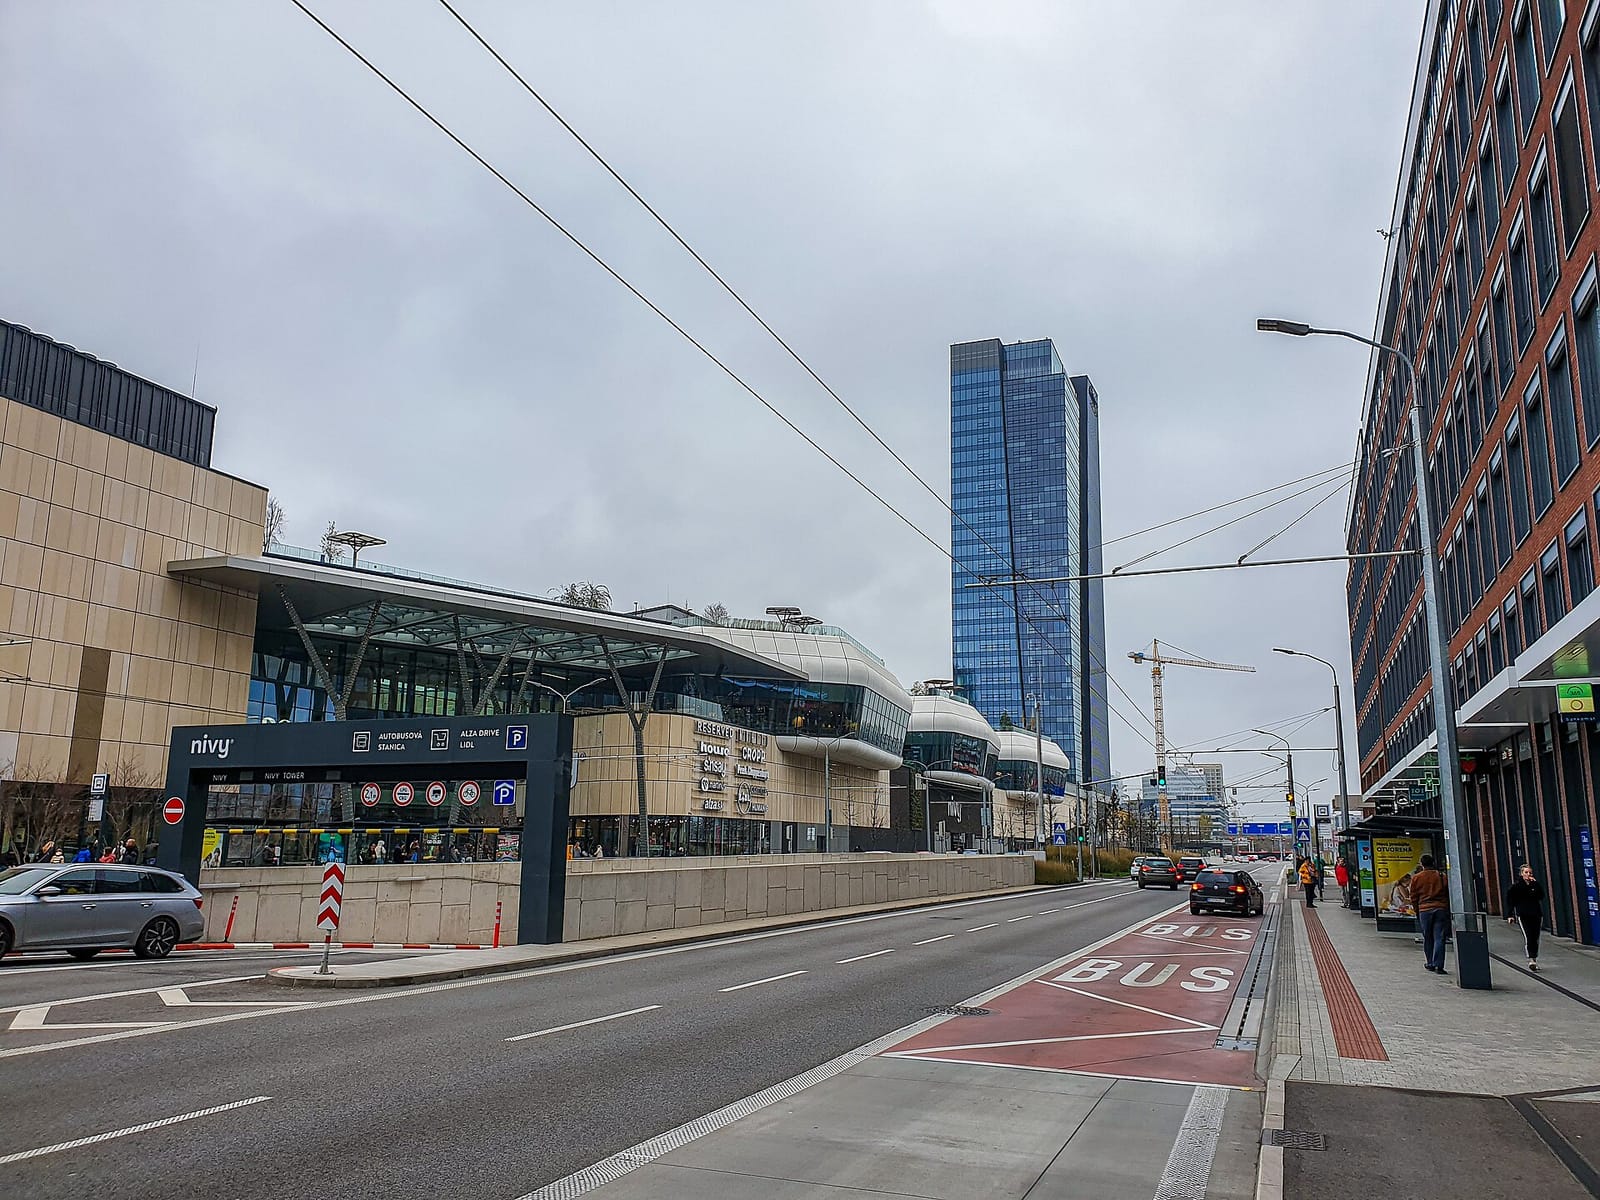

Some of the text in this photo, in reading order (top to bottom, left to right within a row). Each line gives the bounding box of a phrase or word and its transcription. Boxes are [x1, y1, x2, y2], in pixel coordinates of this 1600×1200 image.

[378, 730, 423, 740] AUTOBUSOVÁ
[460, 729, 500, 738] ALZA DRIVE
[697, 720, 734, 739] RESERVED
[190, 733, 230, 759] nivy
[460, 741, 475, 749] LIDL
[513, 733, 522, 746] P
[378, 743, 406, 751] STANICA
[742, 746, 766, 763] CROPP
[264, 771, 305, 780] NIVY TOWER
[499, 788, 510, 803] P
[1141, 923, 1254, 941] BUS
[1051, 958, 1234, 993] BUS
